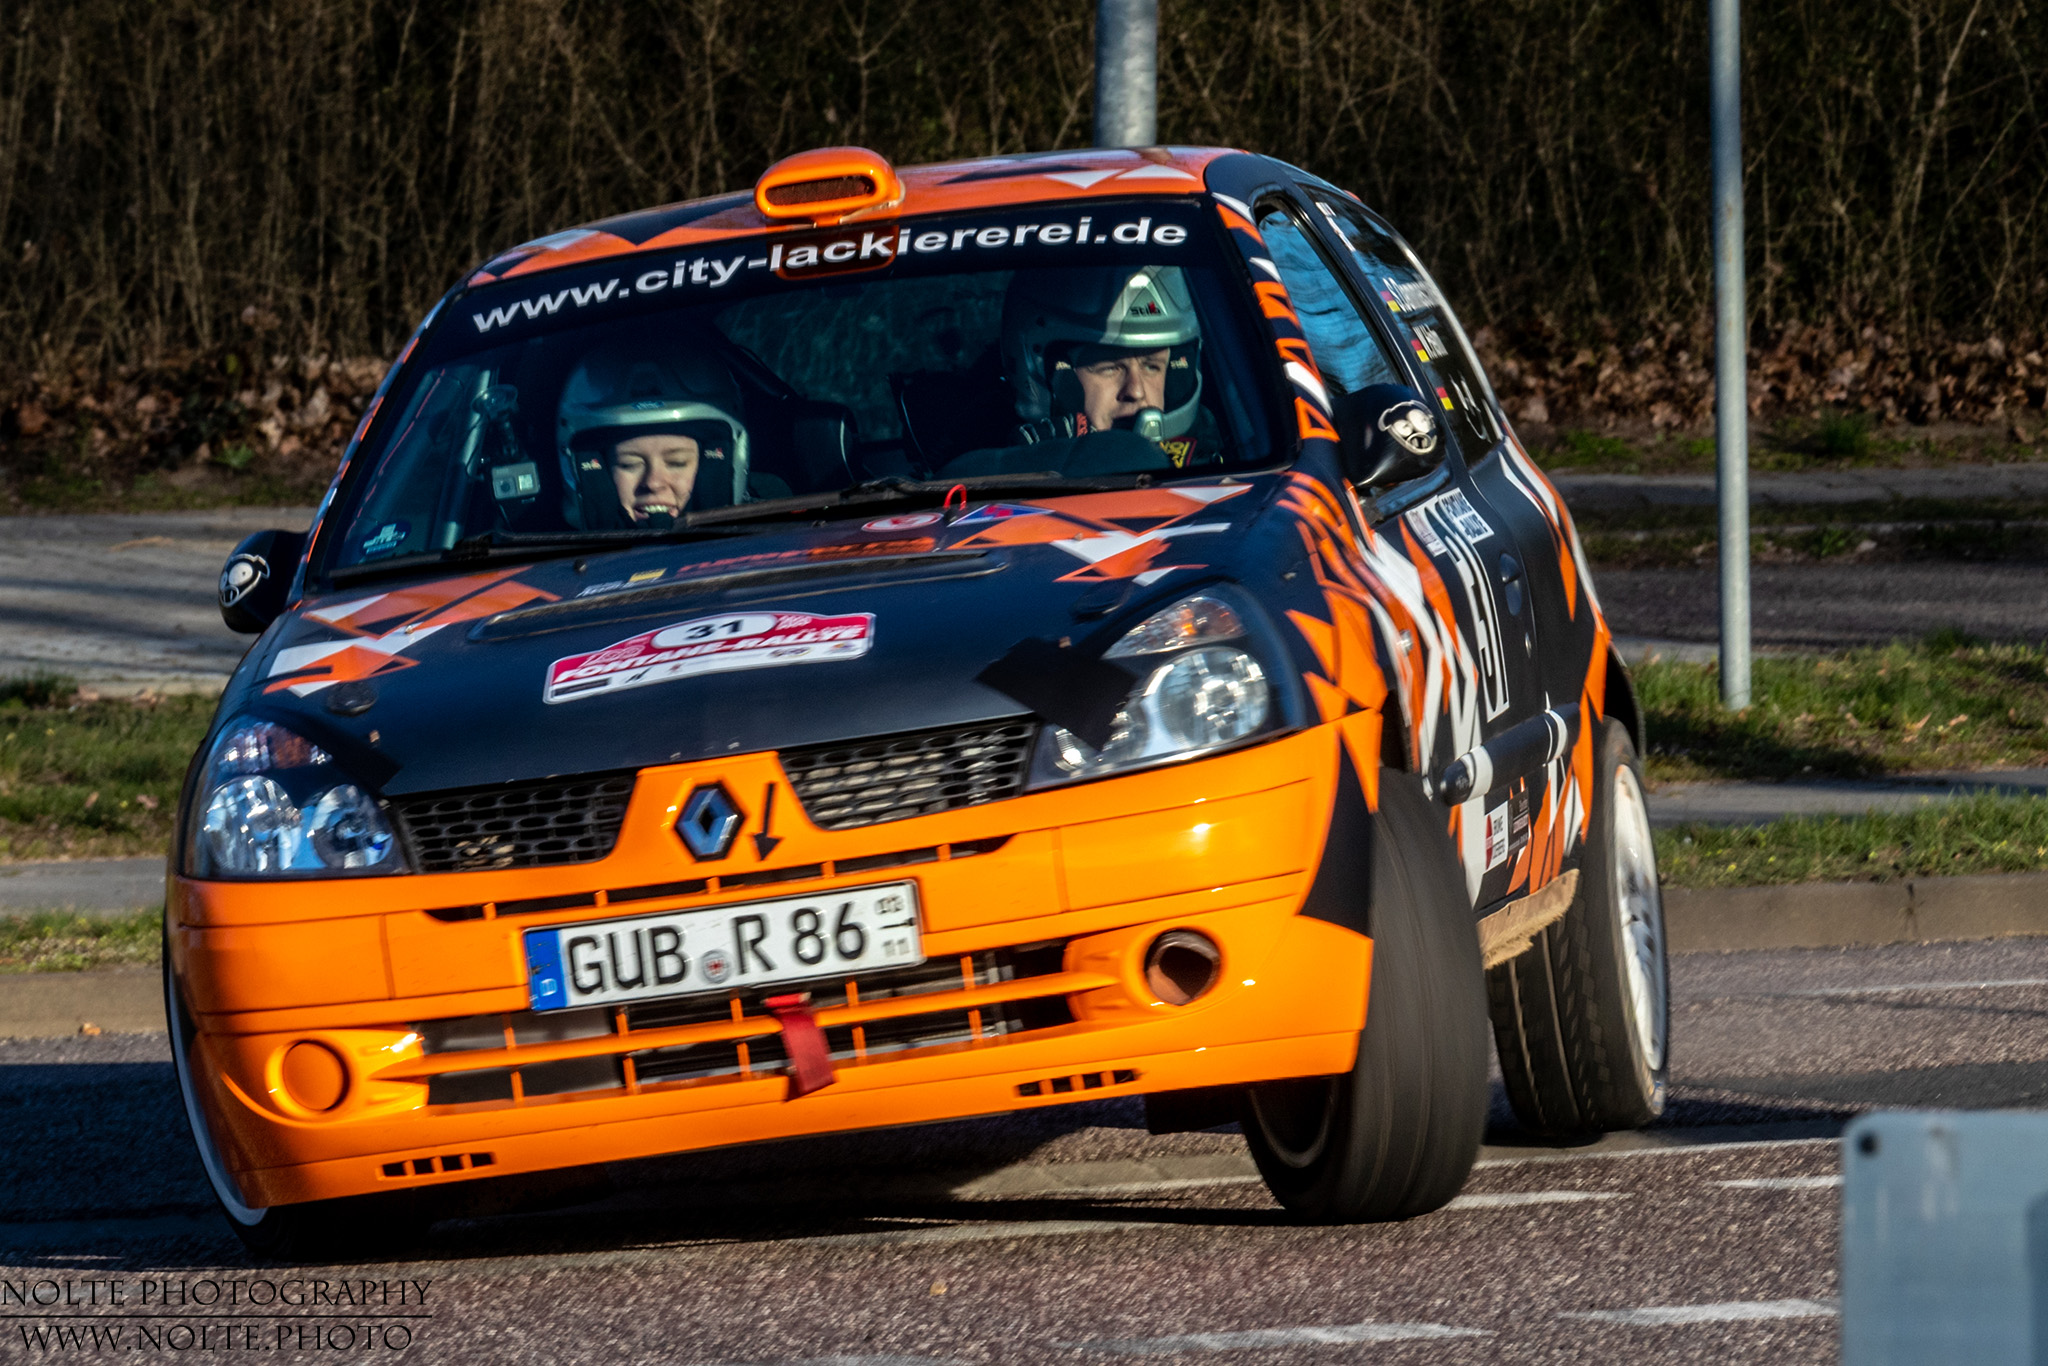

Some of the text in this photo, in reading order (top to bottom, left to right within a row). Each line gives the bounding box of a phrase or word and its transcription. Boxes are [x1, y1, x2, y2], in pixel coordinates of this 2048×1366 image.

[472, 216, 1188, 333] www.city-lackiererei.de
[686, 618, 744, 641] 31
[567, 901, 868, 995] GUB R 86
